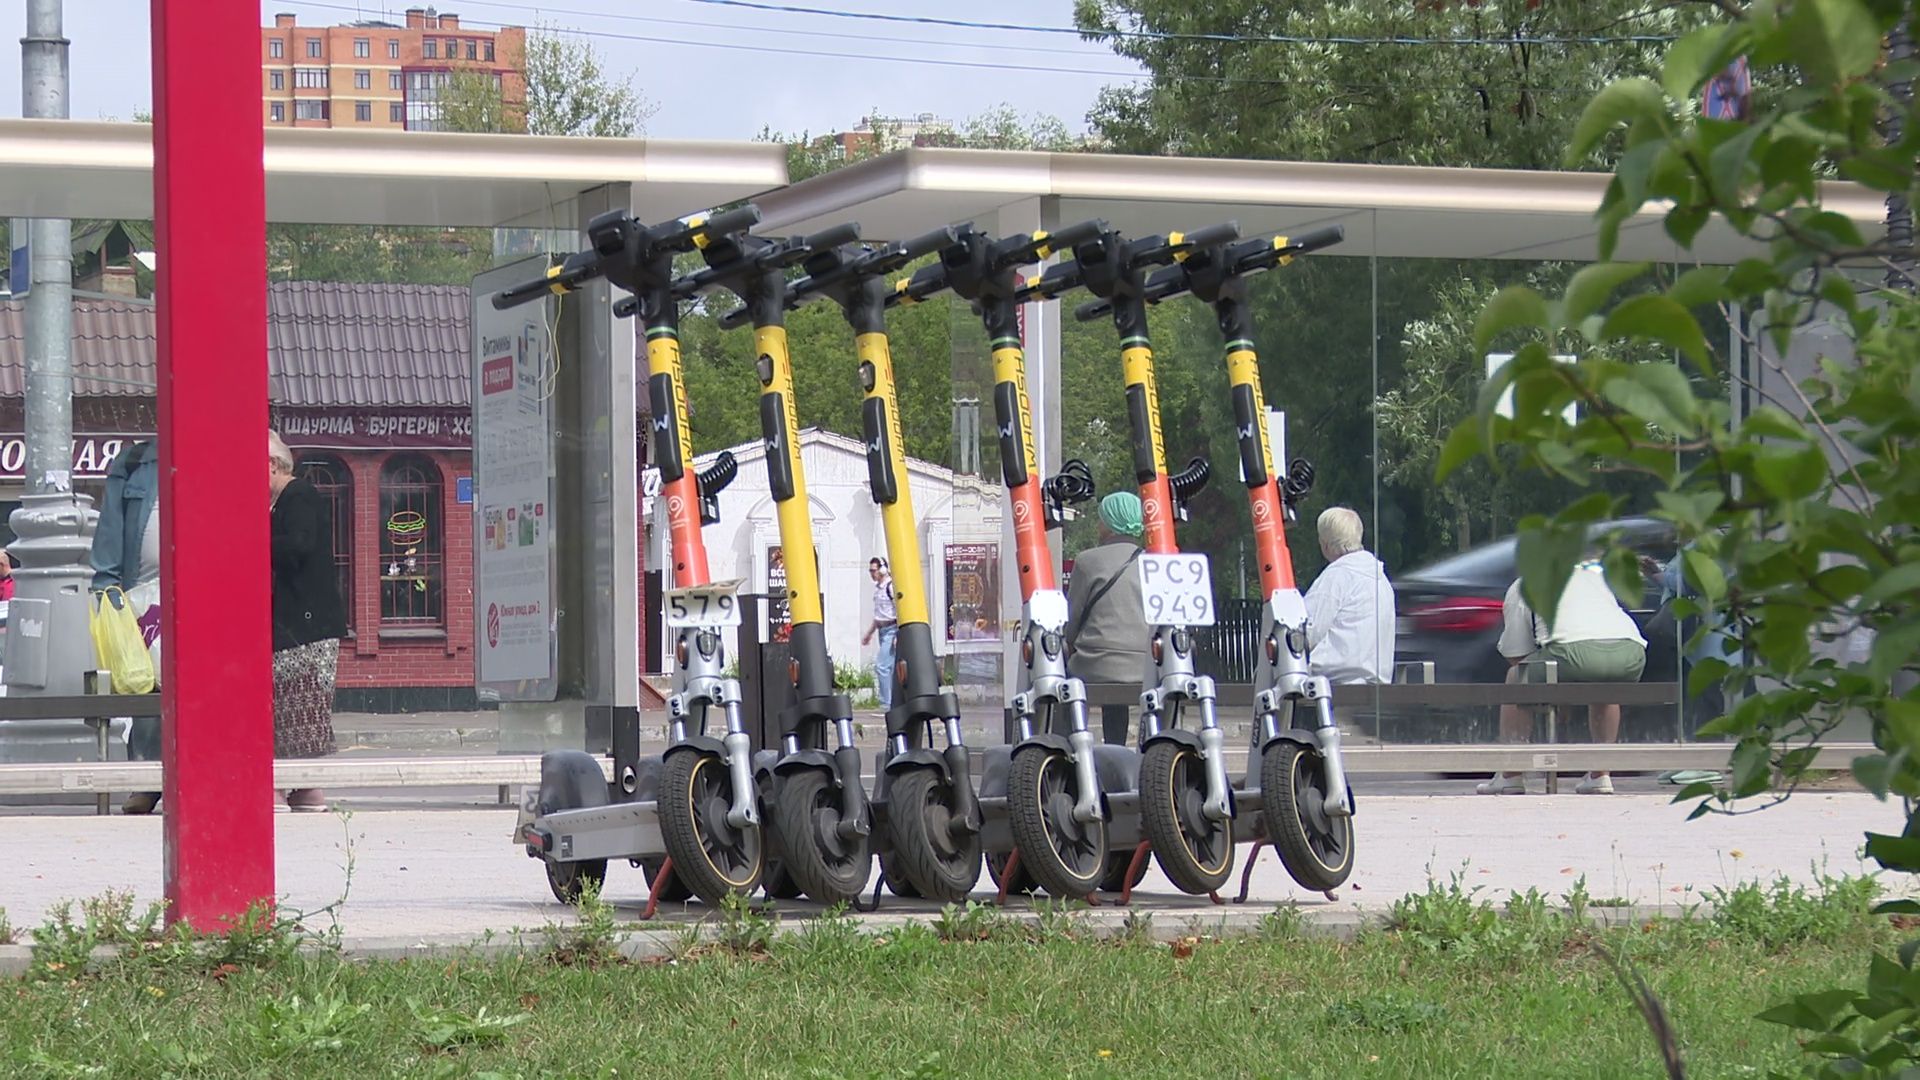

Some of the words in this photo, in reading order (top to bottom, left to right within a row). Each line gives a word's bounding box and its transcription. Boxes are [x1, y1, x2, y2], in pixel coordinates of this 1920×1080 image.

[285, 416, 355, 435] ШАУРМА
[367, 416, 440, 435] БУРГЕРЫ
[670, 346, 693, 463] WHOOSH
[784, 376, 802, 461] WHOOSH
[887, 383, 905, 463] WHOOSH
[1014, 355, 1037, 468] WHOOSH
[1145, 355, 1166, 468] WHOOSH
[671, 594, 734, 620] 579
[1149, 594, 1207, 621] 949
